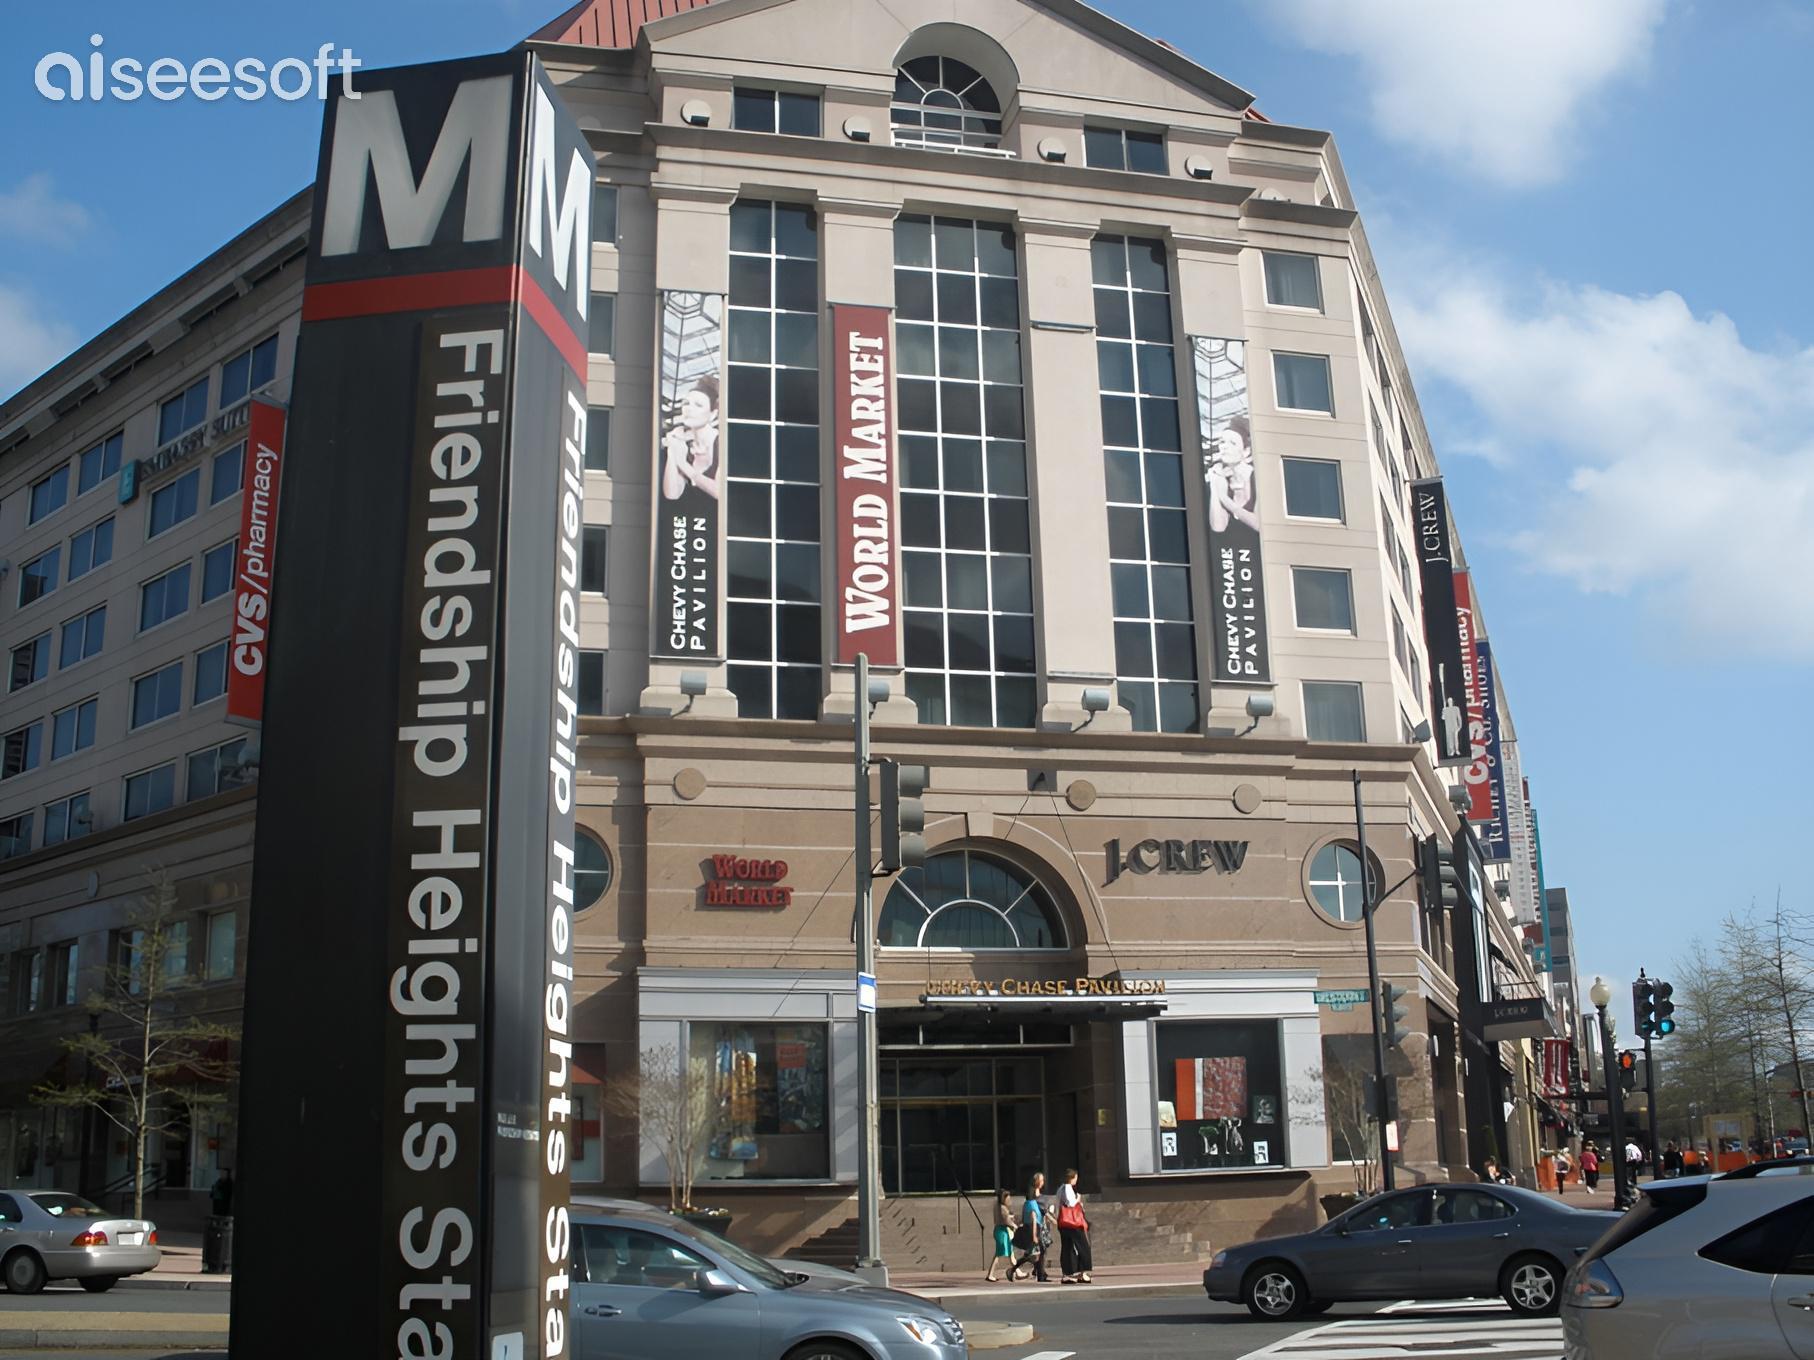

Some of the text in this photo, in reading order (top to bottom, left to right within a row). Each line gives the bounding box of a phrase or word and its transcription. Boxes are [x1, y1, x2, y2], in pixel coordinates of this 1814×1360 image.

[320, 74, 513, 257] M
[529, 81, 592, 322] M
[843, 331, 889, 633] WORLD MARKET
[1418, 492, 1449, 562] J.CREW
[233, 443, 278, 676] CVS/pharmacy
[399, 329, 504, 777] Friendship
[670, 516, 687, 649] CHEVY CHASE
[690, 517, 706, 650] PAVILION
[1239, 549, 1259, 675] PAVILION
[1225, 613, 1241, 675] CHEVY
[544, 389, 586, 1358] Friendship Heights Sta
[705, 880, 794, 907] MARKET
[712, 853, 788, 879] WORLD
[390, 809, 481, 1171] Heights
[1001, 978, 1067, 995] CHASE
